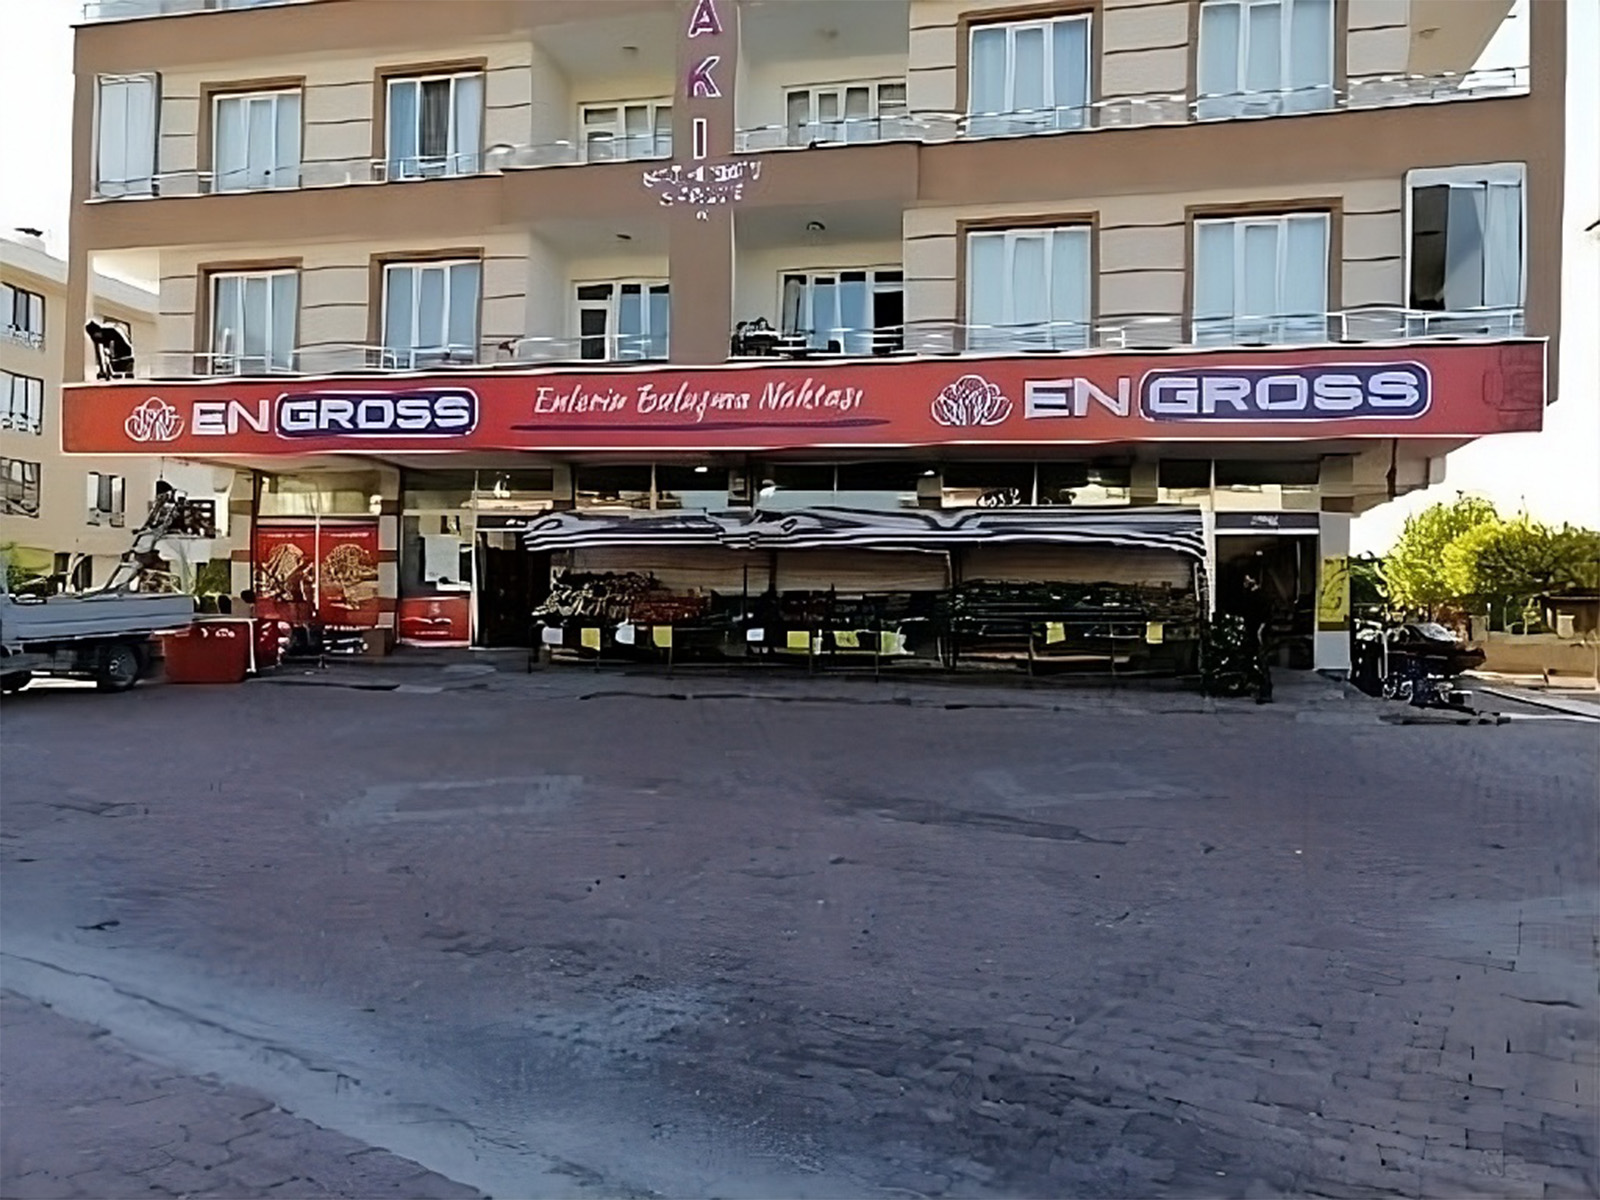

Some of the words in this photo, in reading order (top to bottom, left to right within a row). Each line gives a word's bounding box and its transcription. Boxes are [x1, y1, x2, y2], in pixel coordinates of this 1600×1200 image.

[191, 399, 269, 436] EN
[280, 395, 471, 431] GROSS
[1023, 377, 1131, 419] EN
[1148, 371, 1420, 415] GROSS
